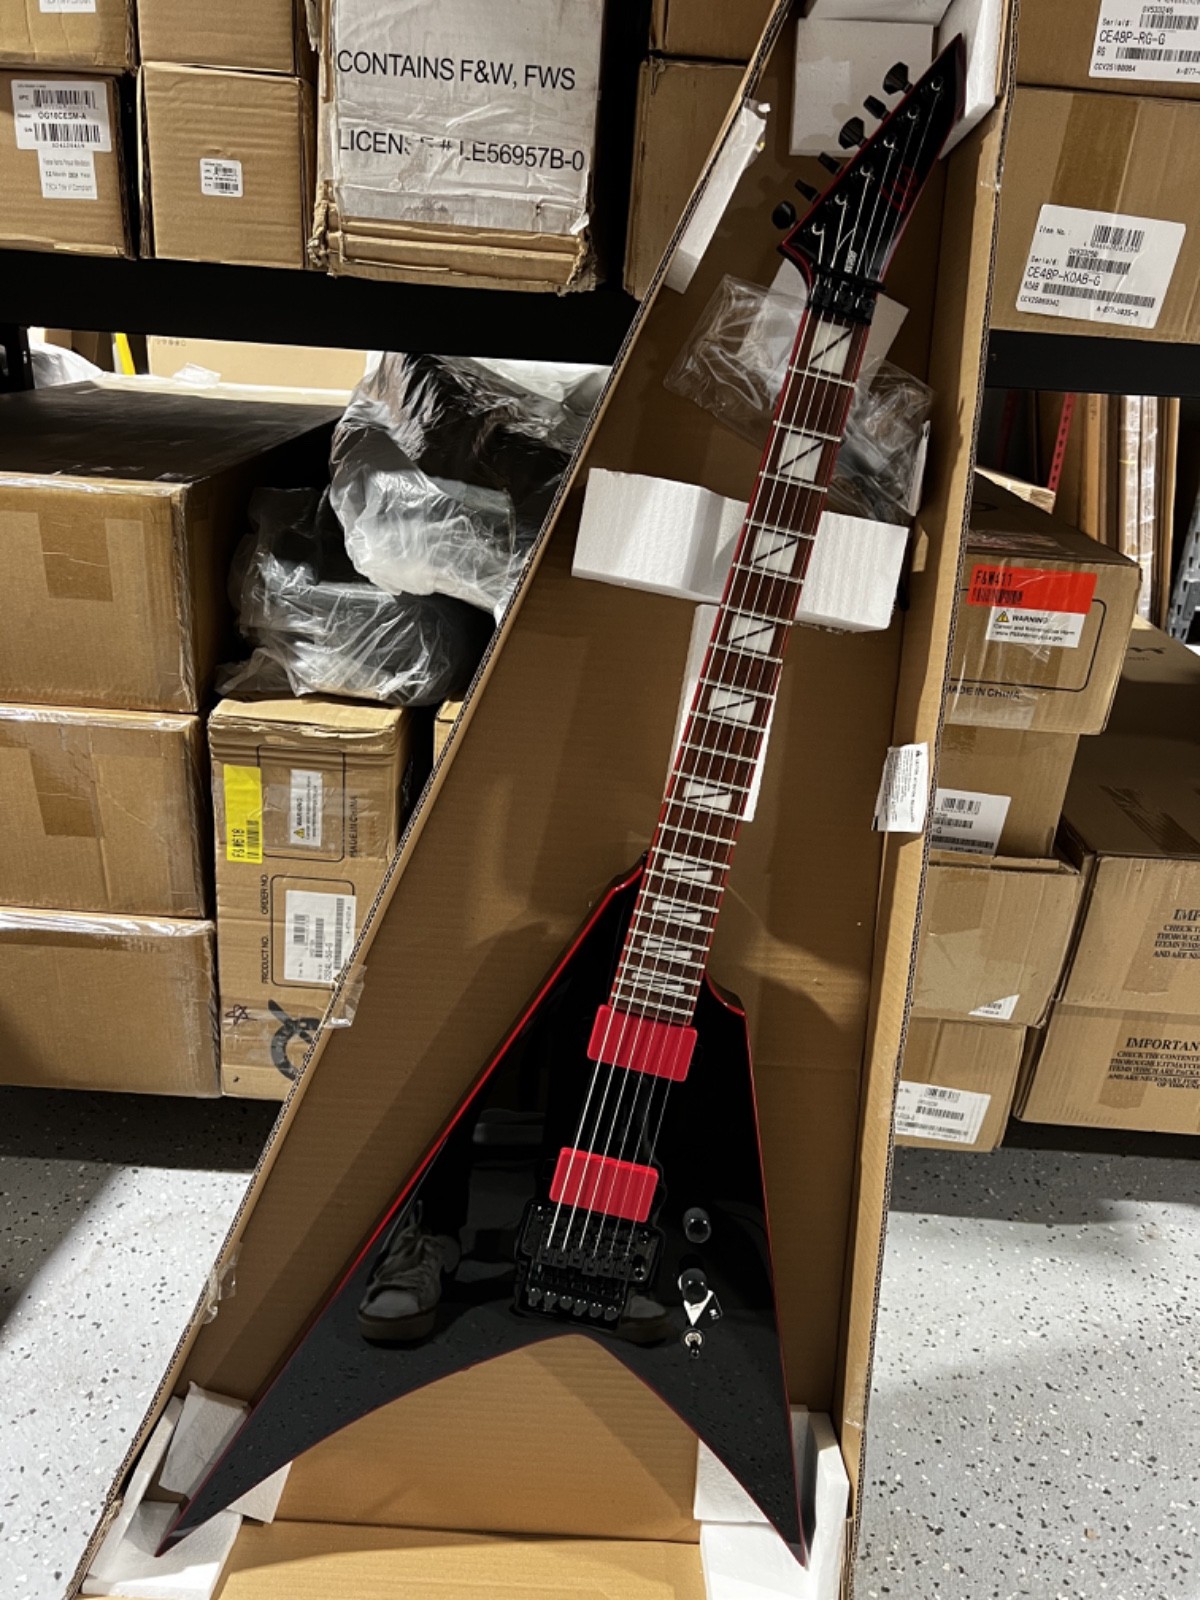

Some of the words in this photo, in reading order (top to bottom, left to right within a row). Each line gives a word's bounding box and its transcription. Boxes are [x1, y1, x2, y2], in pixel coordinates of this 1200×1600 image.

[1099, 29, 1166, 45] CE48P-RG-G
[337, 50, 454, 81] CONTAINS
[460, 59, 517, 89] F&W,
[524, 64, 576, 90] FWS
[337, 129, 435, 156] LICEN
[459, 140, 585, 172] LE56957B-0
[261, 950, 269, 985] PRODUCT
